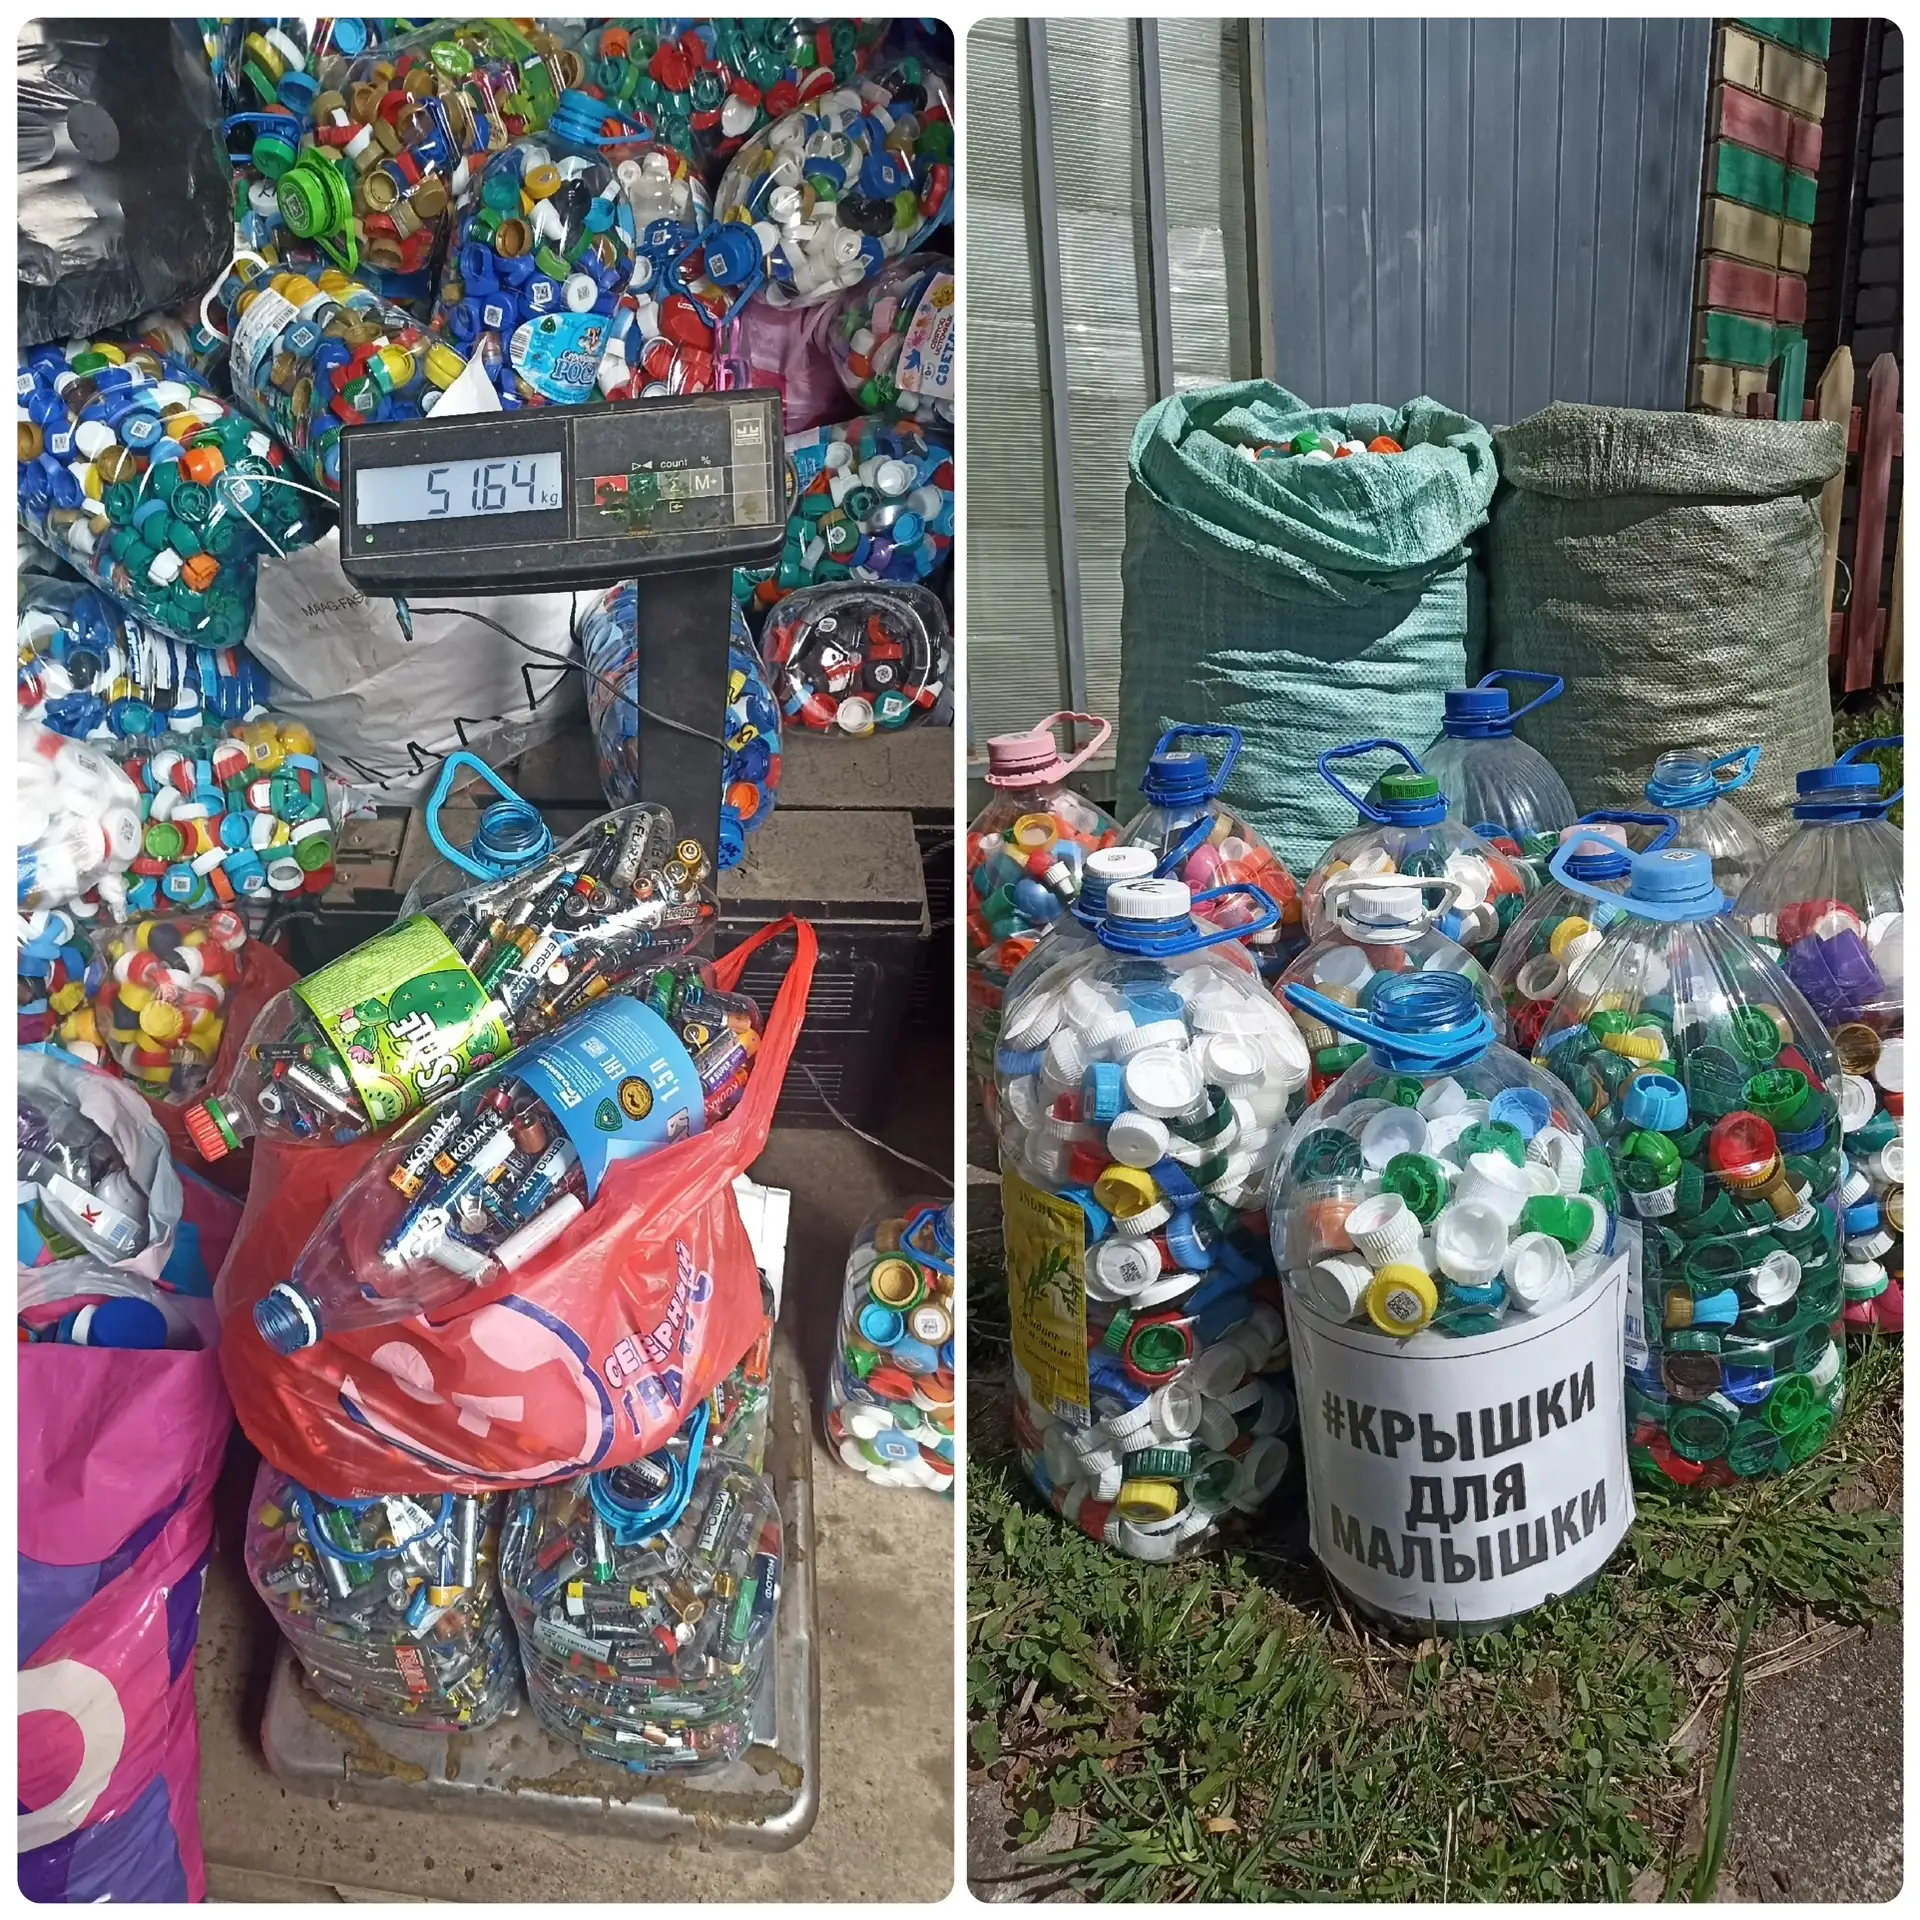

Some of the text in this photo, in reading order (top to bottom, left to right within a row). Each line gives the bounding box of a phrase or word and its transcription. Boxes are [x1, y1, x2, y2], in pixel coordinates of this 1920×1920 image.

[660, 456, 711, 469] count %
[427, 461, 558, 515] 51.64 kg
[695, 475, 717, 491] M+
[547, 888, 570, 918] FLARX
[664, 906, 699, 921] Energizer
[296, 1060, 342, 1095] Energizer
[655, 1071, 680, 1102] 1,5
[713, 1061, 731, 1080] SUPER
[406, 1113, 455, 1166] KODAK
[450, 1121, 492, 1161] KODAK
[519, 1138, 566, 1196] ERGOLUX
[1322, 1361, 1596, 1463] #КРЫШКИ
[700, 1490, 727, 1546] ТРОФИ
[1405, 1462, 1526, 1534] ДЛЯ
[1330, 1478, 1607, 1584] МАЛЫШКИ
[764, 1558, 776, 1599] ФОТОН
